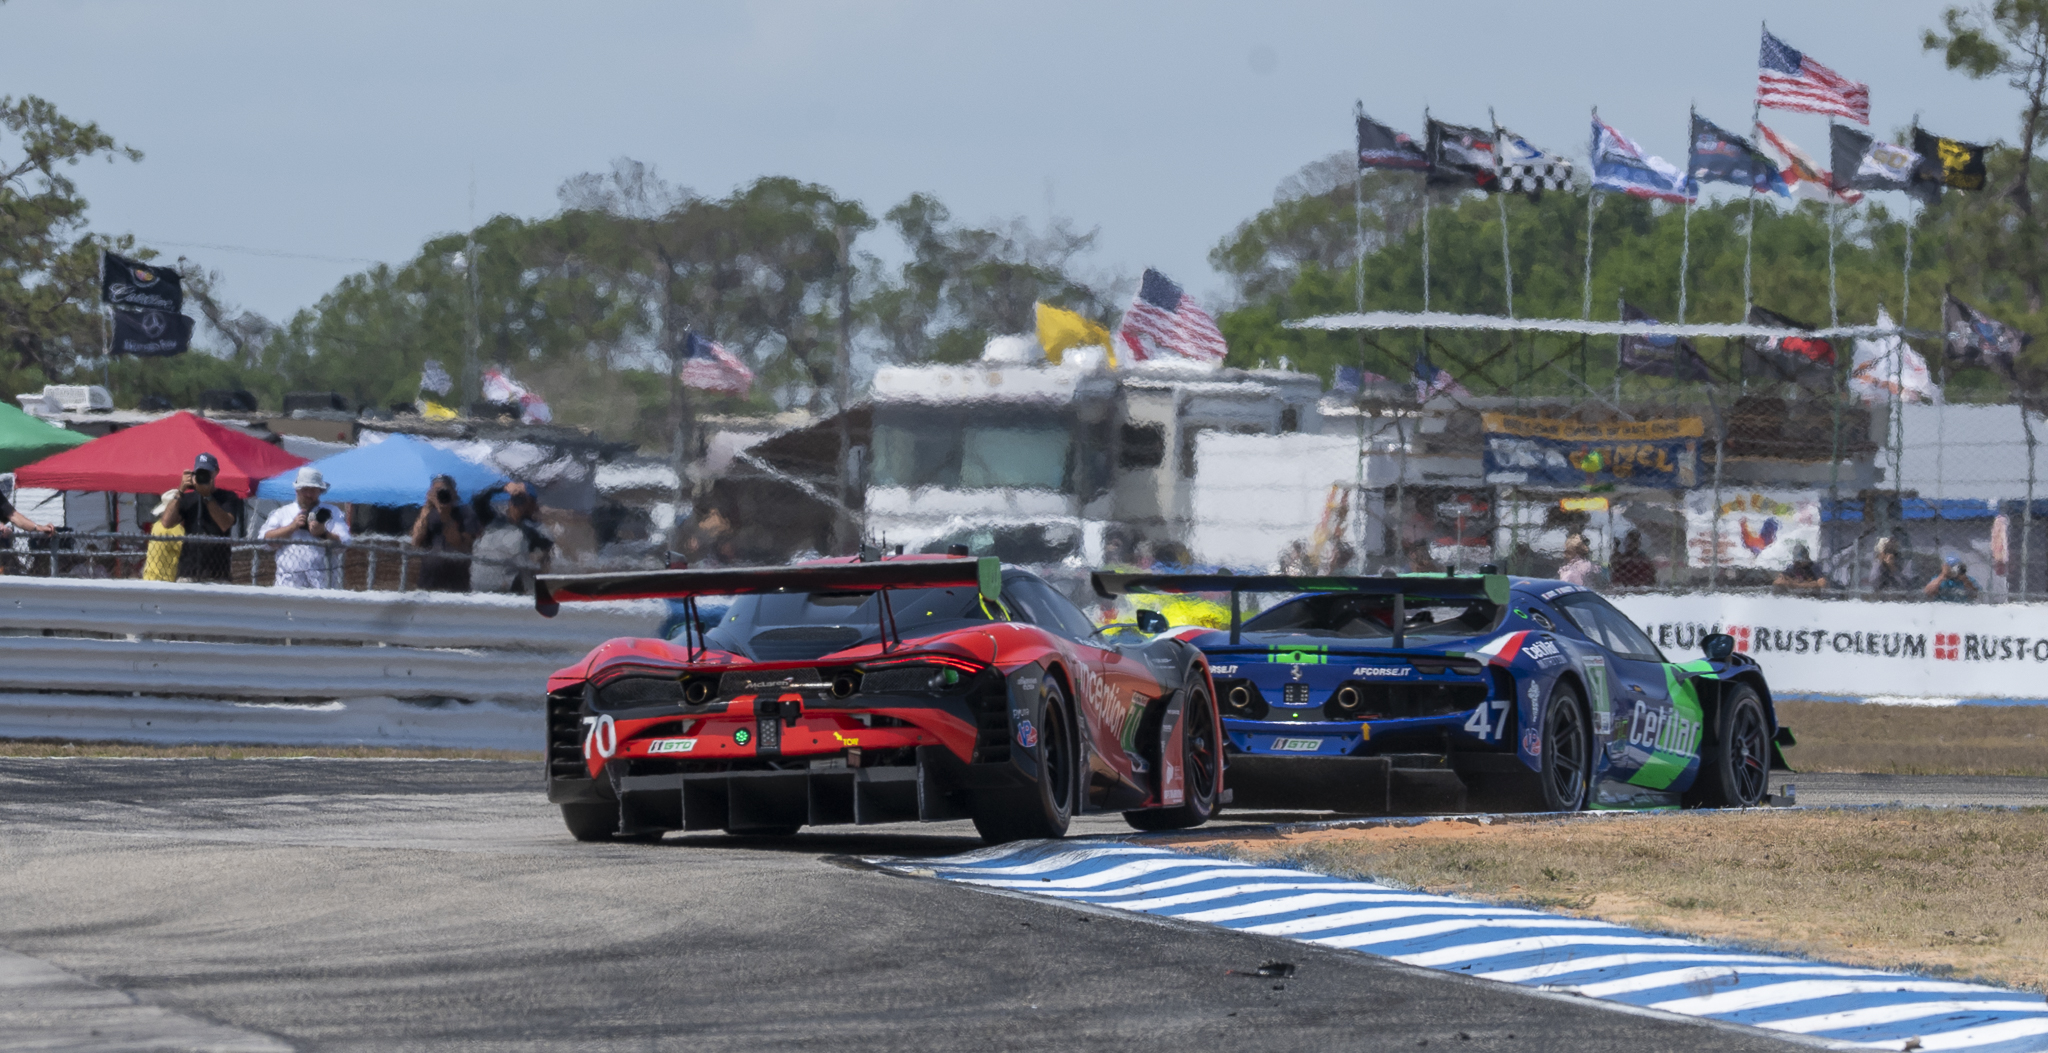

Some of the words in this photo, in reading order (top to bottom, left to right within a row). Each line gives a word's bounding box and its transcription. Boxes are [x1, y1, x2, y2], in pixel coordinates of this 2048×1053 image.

[1521, 641, 1560, 660] Cetilar
[1353, 666, 1411, 677] AFCORSE.IT
[745, 679, 789, 689] McLaren
[1464, 700, 1511, 740] 47
[1629, 699, 1700, 759] Cetilar
[583, 714, 617, 760] 70
[843, 737, 859, 746] TOW
[663, 741, 692, 751] GTD
[1287, 739, 1319, 749] GTD
